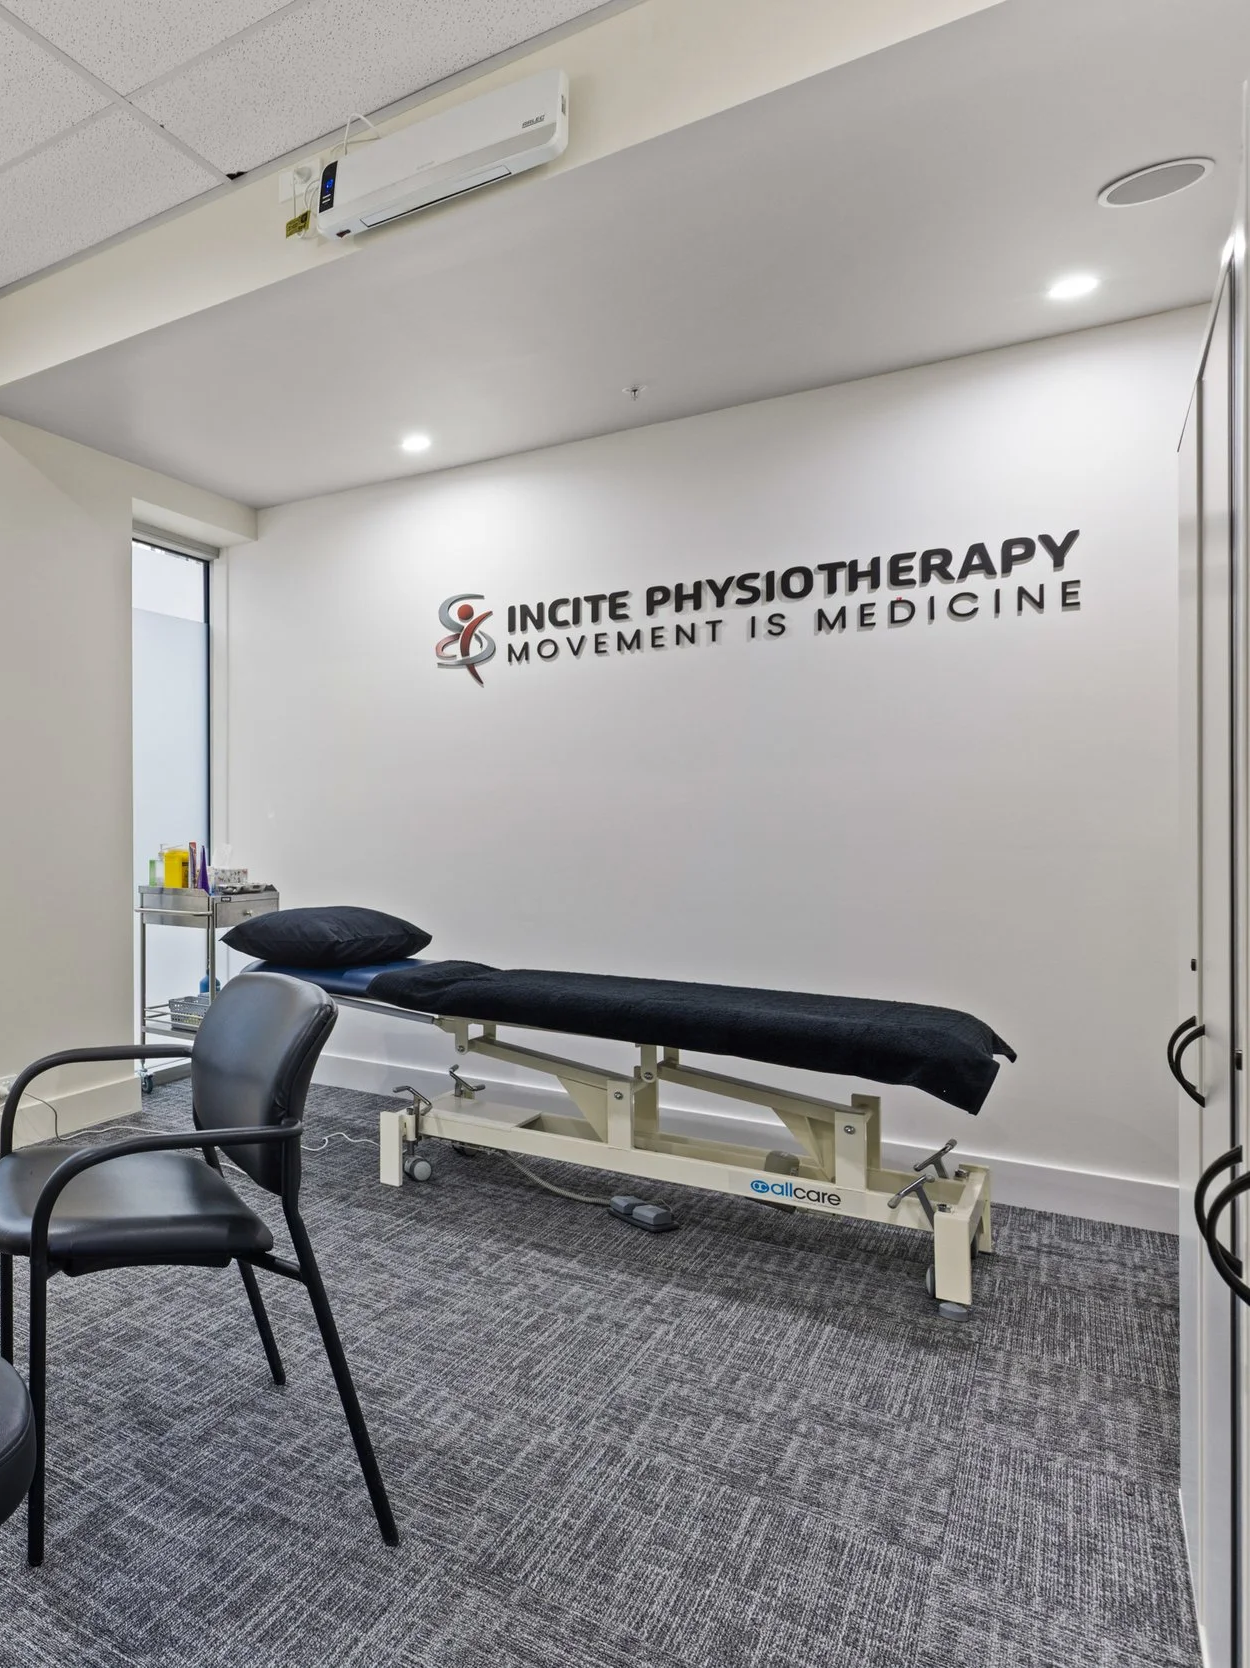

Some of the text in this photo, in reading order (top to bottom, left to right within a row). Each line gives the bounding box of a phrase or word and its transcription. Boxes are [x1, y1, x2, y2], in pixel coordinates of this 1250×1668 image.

[507, 529, 1080, 633] INCITE PHYSIOTHERAPY
[507, 579, 1081, 665] MOVEMENT IS MEDICINE
[770, 1182, 842, 1206] allcare
